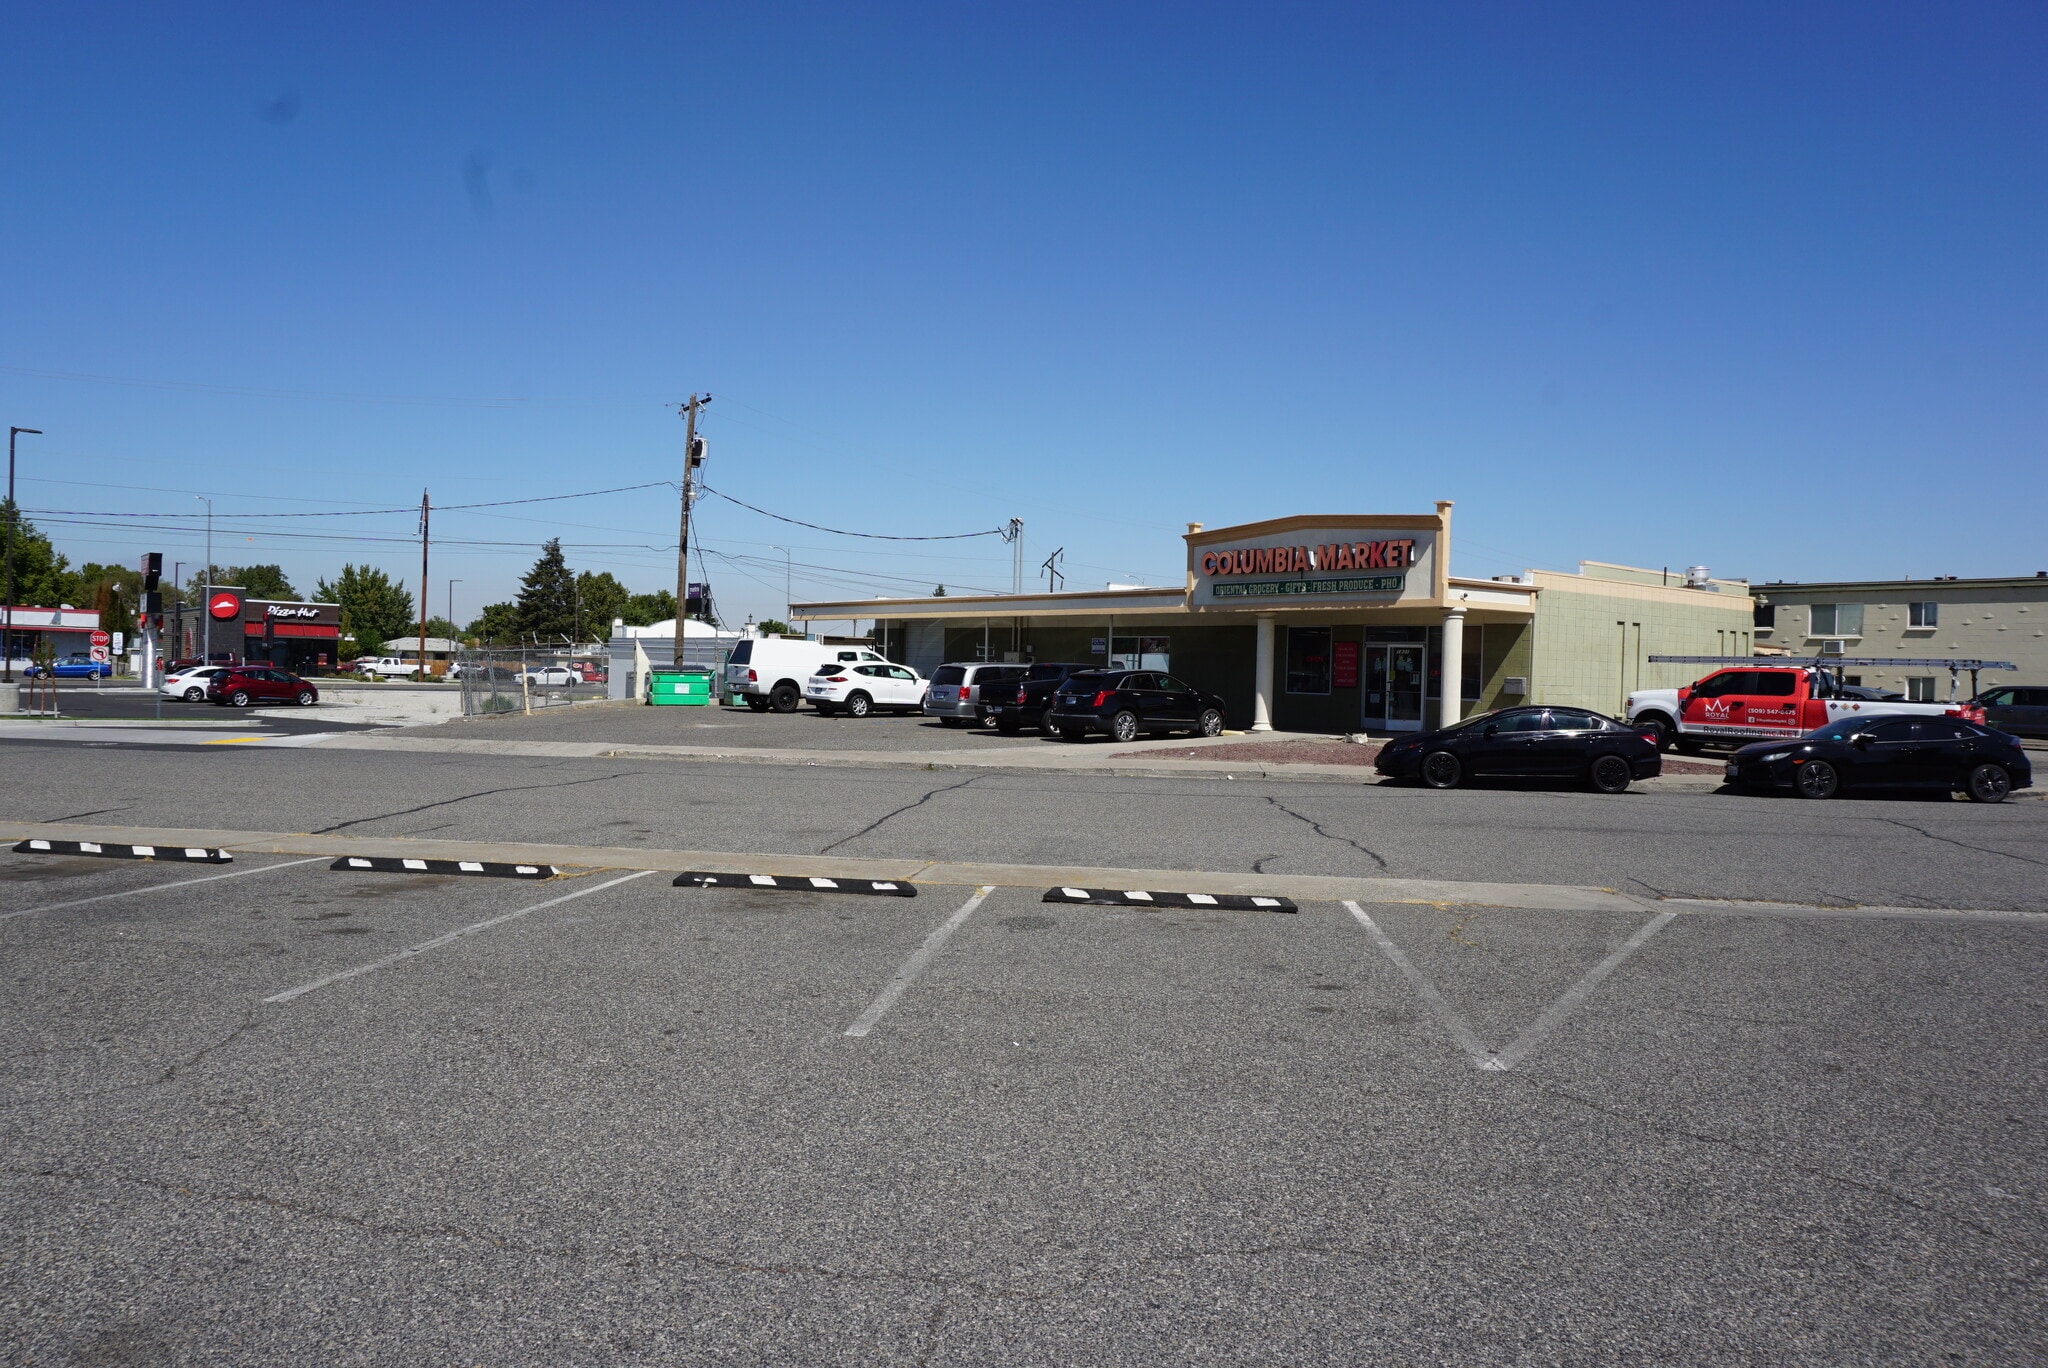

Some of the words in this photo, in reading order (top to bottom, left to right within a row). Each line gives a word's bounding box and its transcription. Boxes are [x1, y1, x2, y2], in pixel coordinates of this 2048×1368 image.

[1201, 546, 1311, 576] COLUMBIA
[1316, 539, 1414, 571] MARKET
[1215, 584, 1247, 595] ORIENTAL
[1248, 583, 1280, 594] GROCERY
[1285, 582, 1307, 593] GIFTS
[1312, 581, 1337, 592] FRESH
[1338, 579, 1374, 591] PRODUCE
[1381, 578, 1398, 589] PHO
[267, 605, 297, 617] Pizza
[297, 607, 320, 618] Hut
